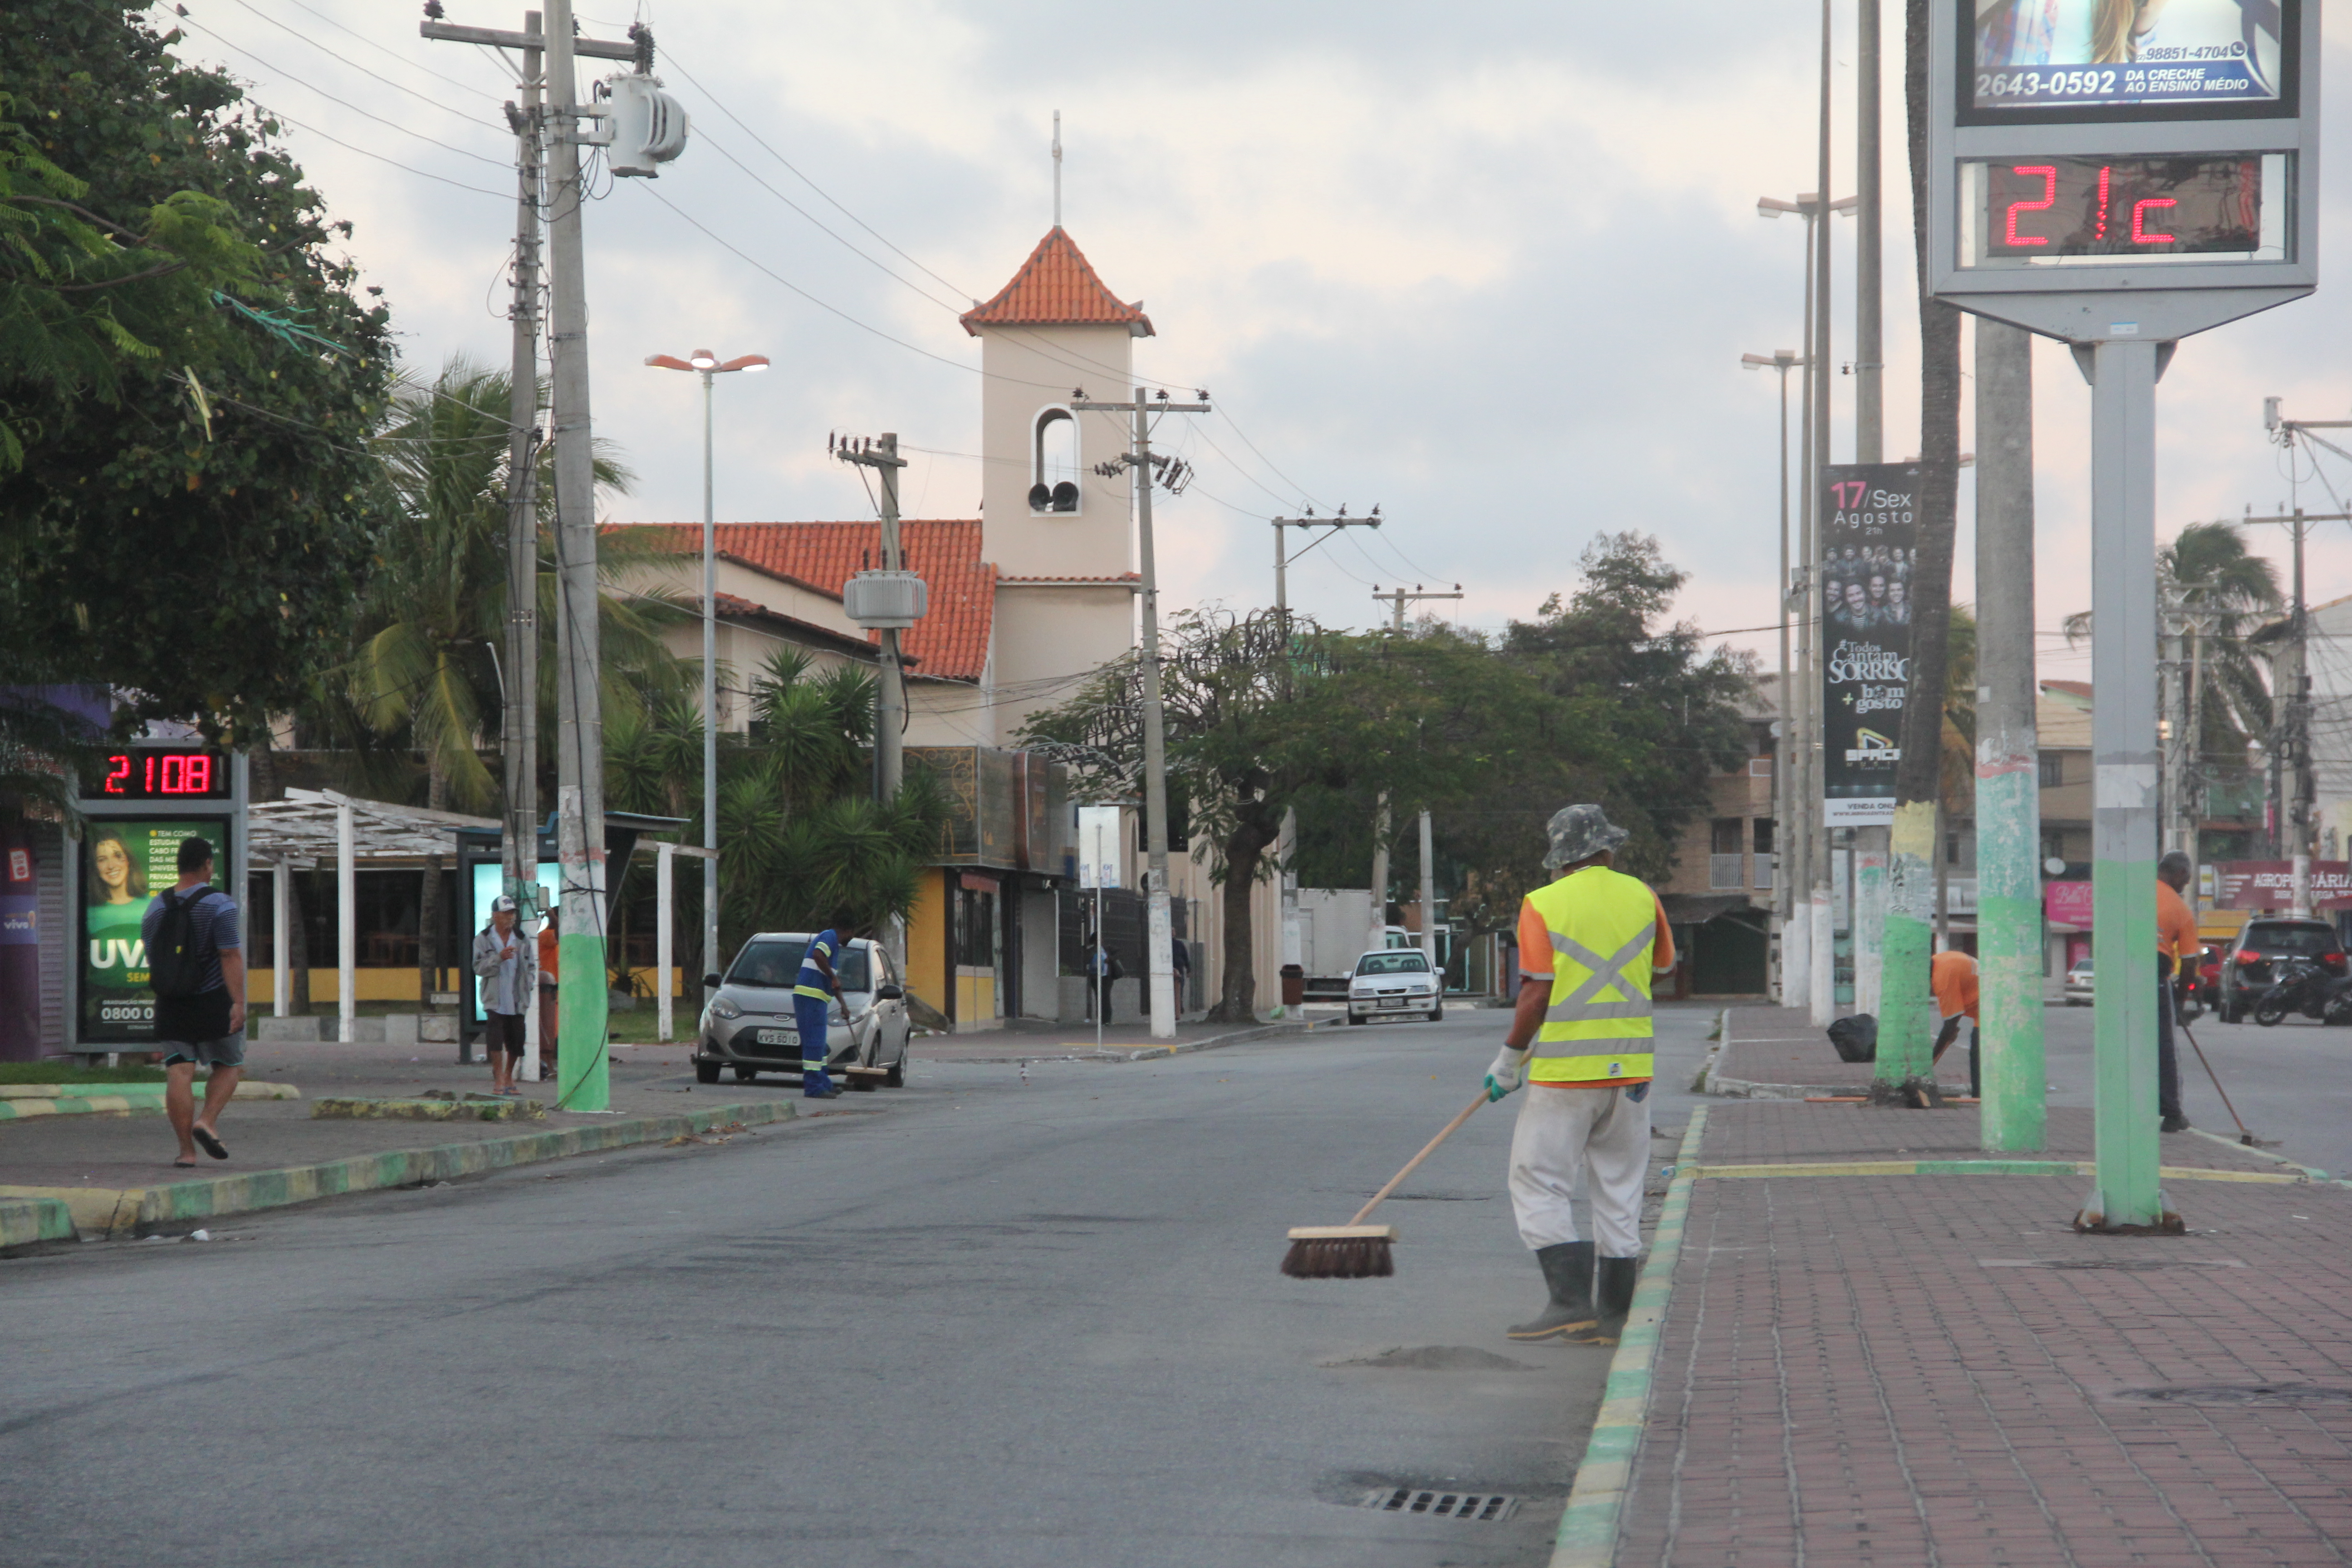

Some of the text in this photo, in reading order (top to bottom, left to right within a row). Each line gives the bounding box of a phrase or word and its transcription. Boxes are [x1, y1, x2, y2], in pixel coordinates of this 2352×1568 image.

[2146, 46, 2230, 60] 98851-4704
[2125, 69, 2206, 81] DA CRECHE
[1977, 70, 2116, 96] 2643-0592
[2125, 77, 2249, 93] AO ENSINO MÉDIO
[1834, 510, 1912, 529] Agosto
[1866, 527, 1883, 535] 21h
[1856, 698, 1903, 714] gosto
[101, 1007, 141, 1019] 0800
